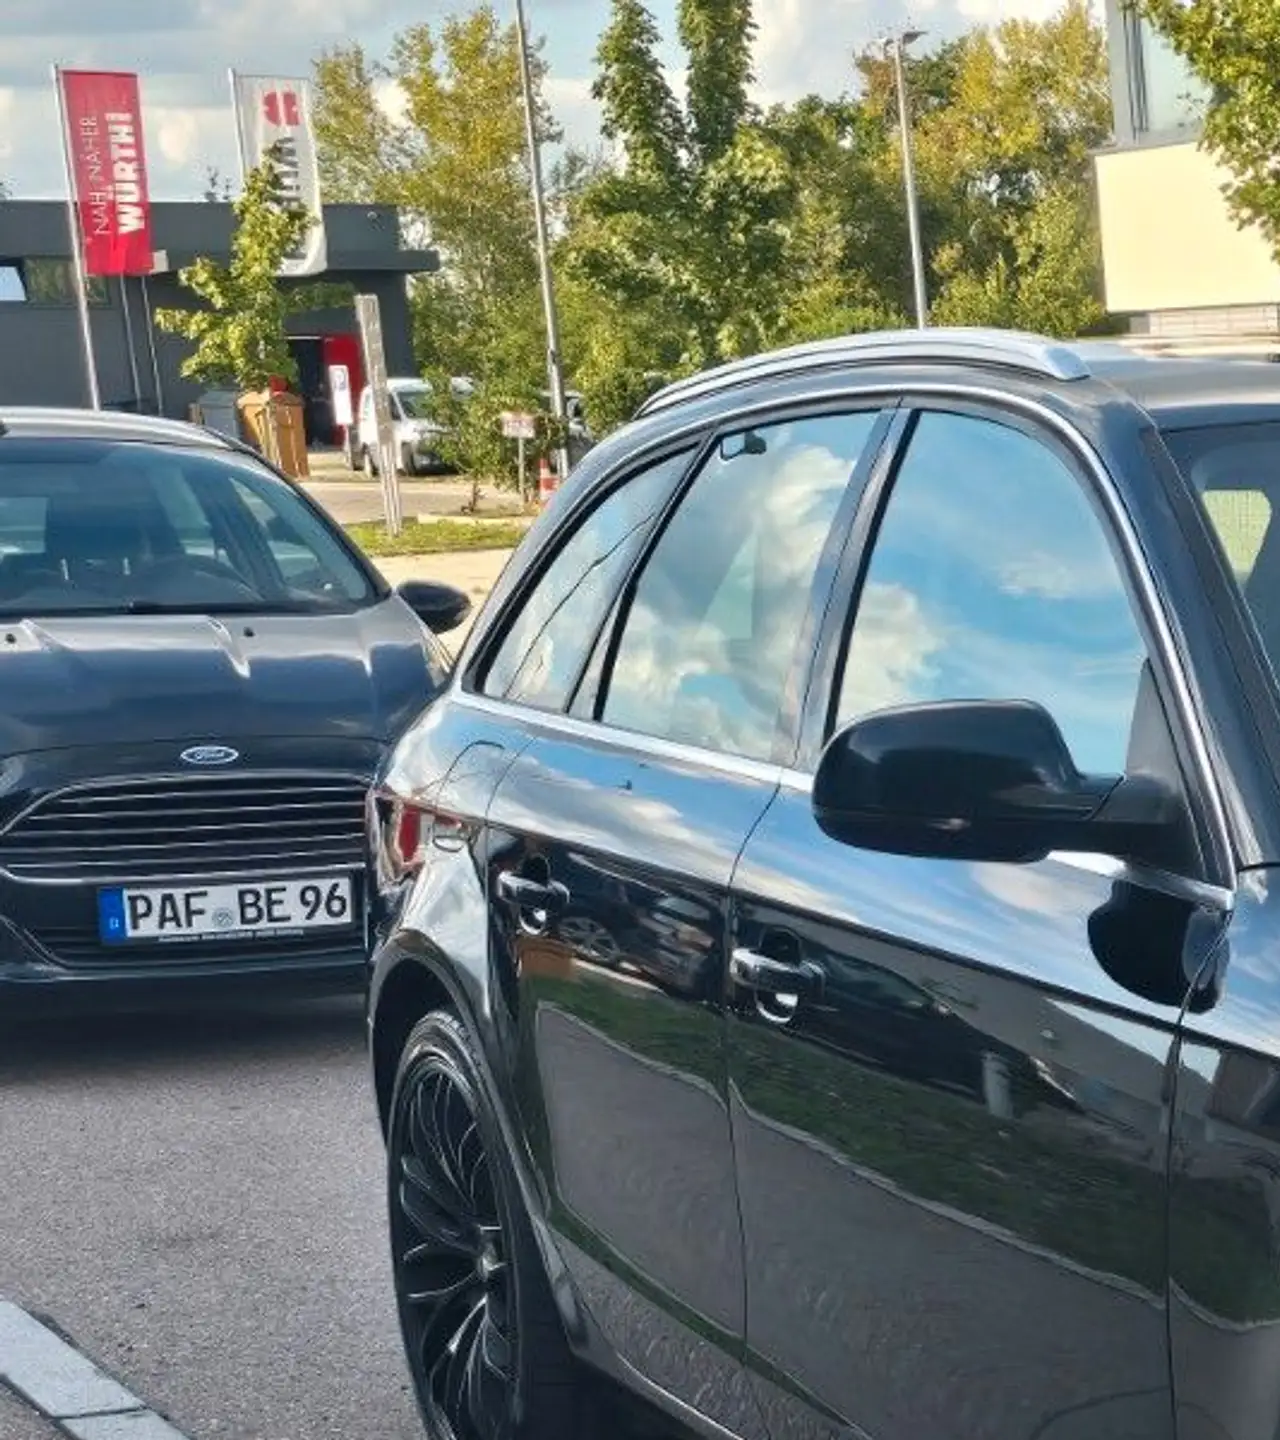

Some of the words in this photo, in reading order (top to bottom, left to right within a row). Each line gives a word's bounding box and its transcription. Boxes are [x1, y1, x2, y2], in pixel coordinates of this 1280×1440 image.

[104, 112, 145, 235] WÜRTH!
[127, 890, 208, 930] PAF
[237, 886, 291, 925] BE
[300, 882, 347, 920] 96
